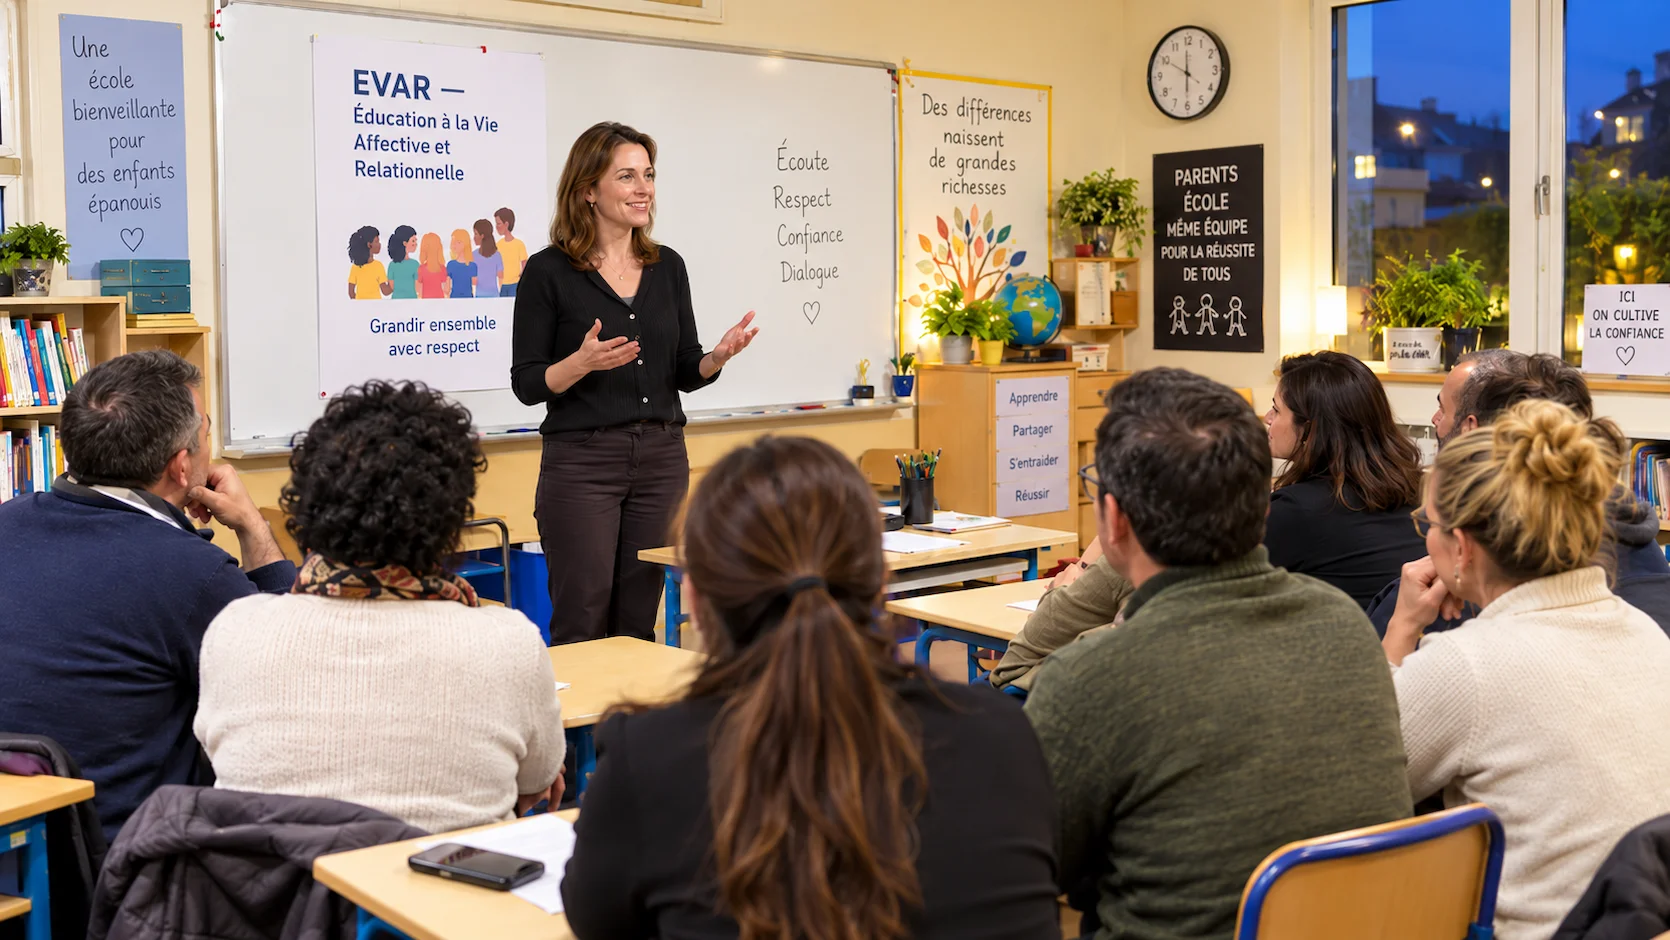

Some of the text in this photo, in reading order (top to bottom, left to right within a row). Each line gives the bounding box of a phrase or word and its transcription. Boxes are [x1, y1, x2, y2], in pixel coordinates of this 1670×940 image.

[73, 36, 109, 58] Une
[1171, 42, 1180, 52] 11
[1183, 35, 1193, 46] 12
[1199, 39, 1204, 49] 1
[1161, 55, 1170, 66] 10
[1207, 48, 1214, 60] 2
[88, 65, 134, 89] école
[1157, 71, 1163, 81] 9
[1211, 64, 1219, 76] 3
[354, 69, 430, 100] EVAR
[1162, 87, 1168, 98] 8
[1207, 82, 1214, 92] 4
[73, 98, 176, 120] bienveillante
[922, 93, 1031, 125] Des différences
[1172, 98, 1178, 108] 7
[1184, 100, 1191, 111] 6
[1198, 95, 1204, 106] 5
[353, 103, 498, 132] Éducation à la Vie
[354, 134, 450, 154] Affective et
[944, 129, 1004, 147] naissent
[109, 136, 145, 158] pour
[778, 139, 829, 171] Écoute
[356, 160, 463, 180] Relationnelle
[930, 148, 1016, 177] de grandes
[78, 160, 174, 188] des enfants
[1175, 165, 1238, 186] PARENTS
[942, 178, 1007, 195] richesses
[89, 193, 161, 222] épanouis
[773, 185, 831, 217] Respect
[1184, 190, 1229, 212] ÉCOLE
[1204, 217, 1248, 235] ÉQUIPE
[778, 223, 843, 254] Confiance
[1161, 241, 1255, 259] POUR LA RÉUSSITE
[781, 260, 839, 289] Dialogue
[1184, 267, 1231, 281] DE TOUS
[1620, 291, 1634, 302] ICI
[1593, 310, 1659, 321] ON CULTIVE
[371, 316, 495, 333] Grandir ensemble
[1590, 328, 1664, 339] LA CONFIANCE
[389, 340, 479, 357] avec respect
[1010, 390, 1058, 407] Apprendre
[1013, 425, 1053, 438] Partager
[1016, 488, 1049, 501] Réussir
